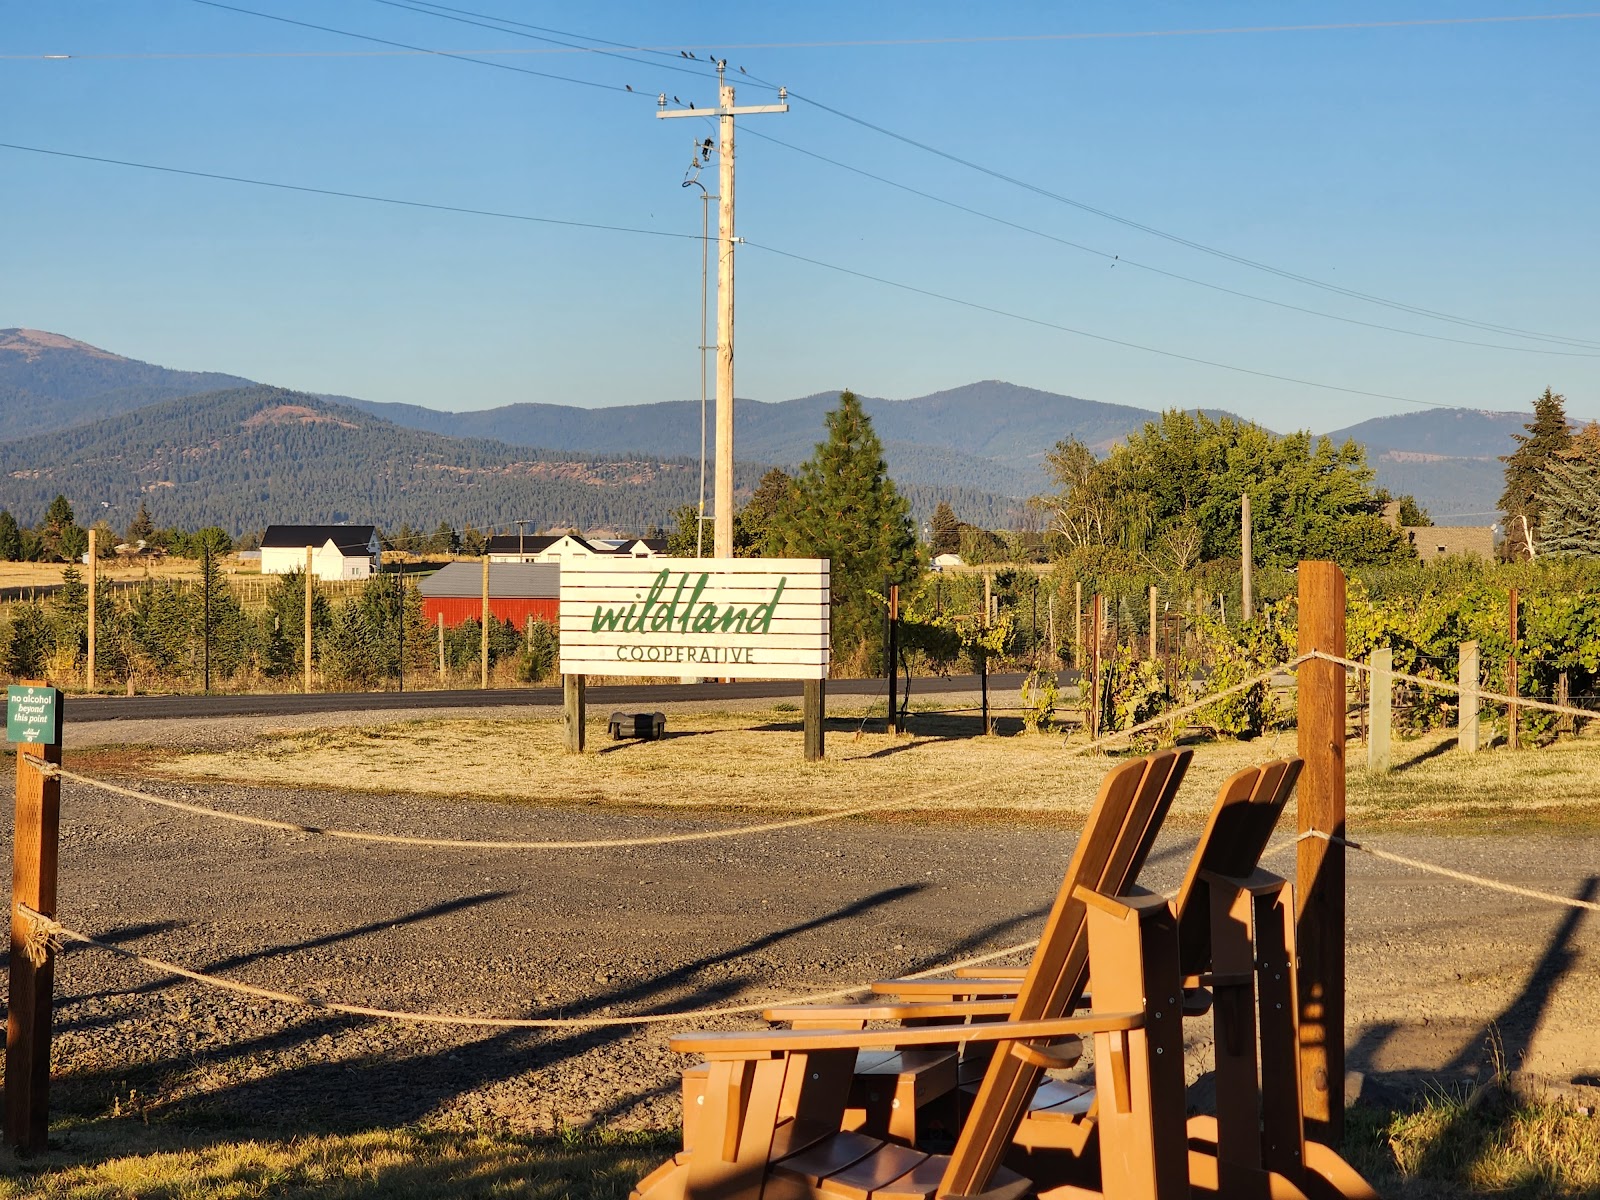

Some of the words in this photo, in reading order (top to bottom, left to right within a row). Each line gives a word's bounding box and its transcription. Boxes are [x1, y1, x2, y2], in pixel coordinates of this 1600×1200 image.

[591, 568, 787, 635] wildland
[617, 645, 754, 663] COOPERATIVE
[23, 695, 52, 704] alcohol
[18, 704, 45, 714] beyond
[14, 713, 28, 721] this
[28, 715, 48, 724] point
